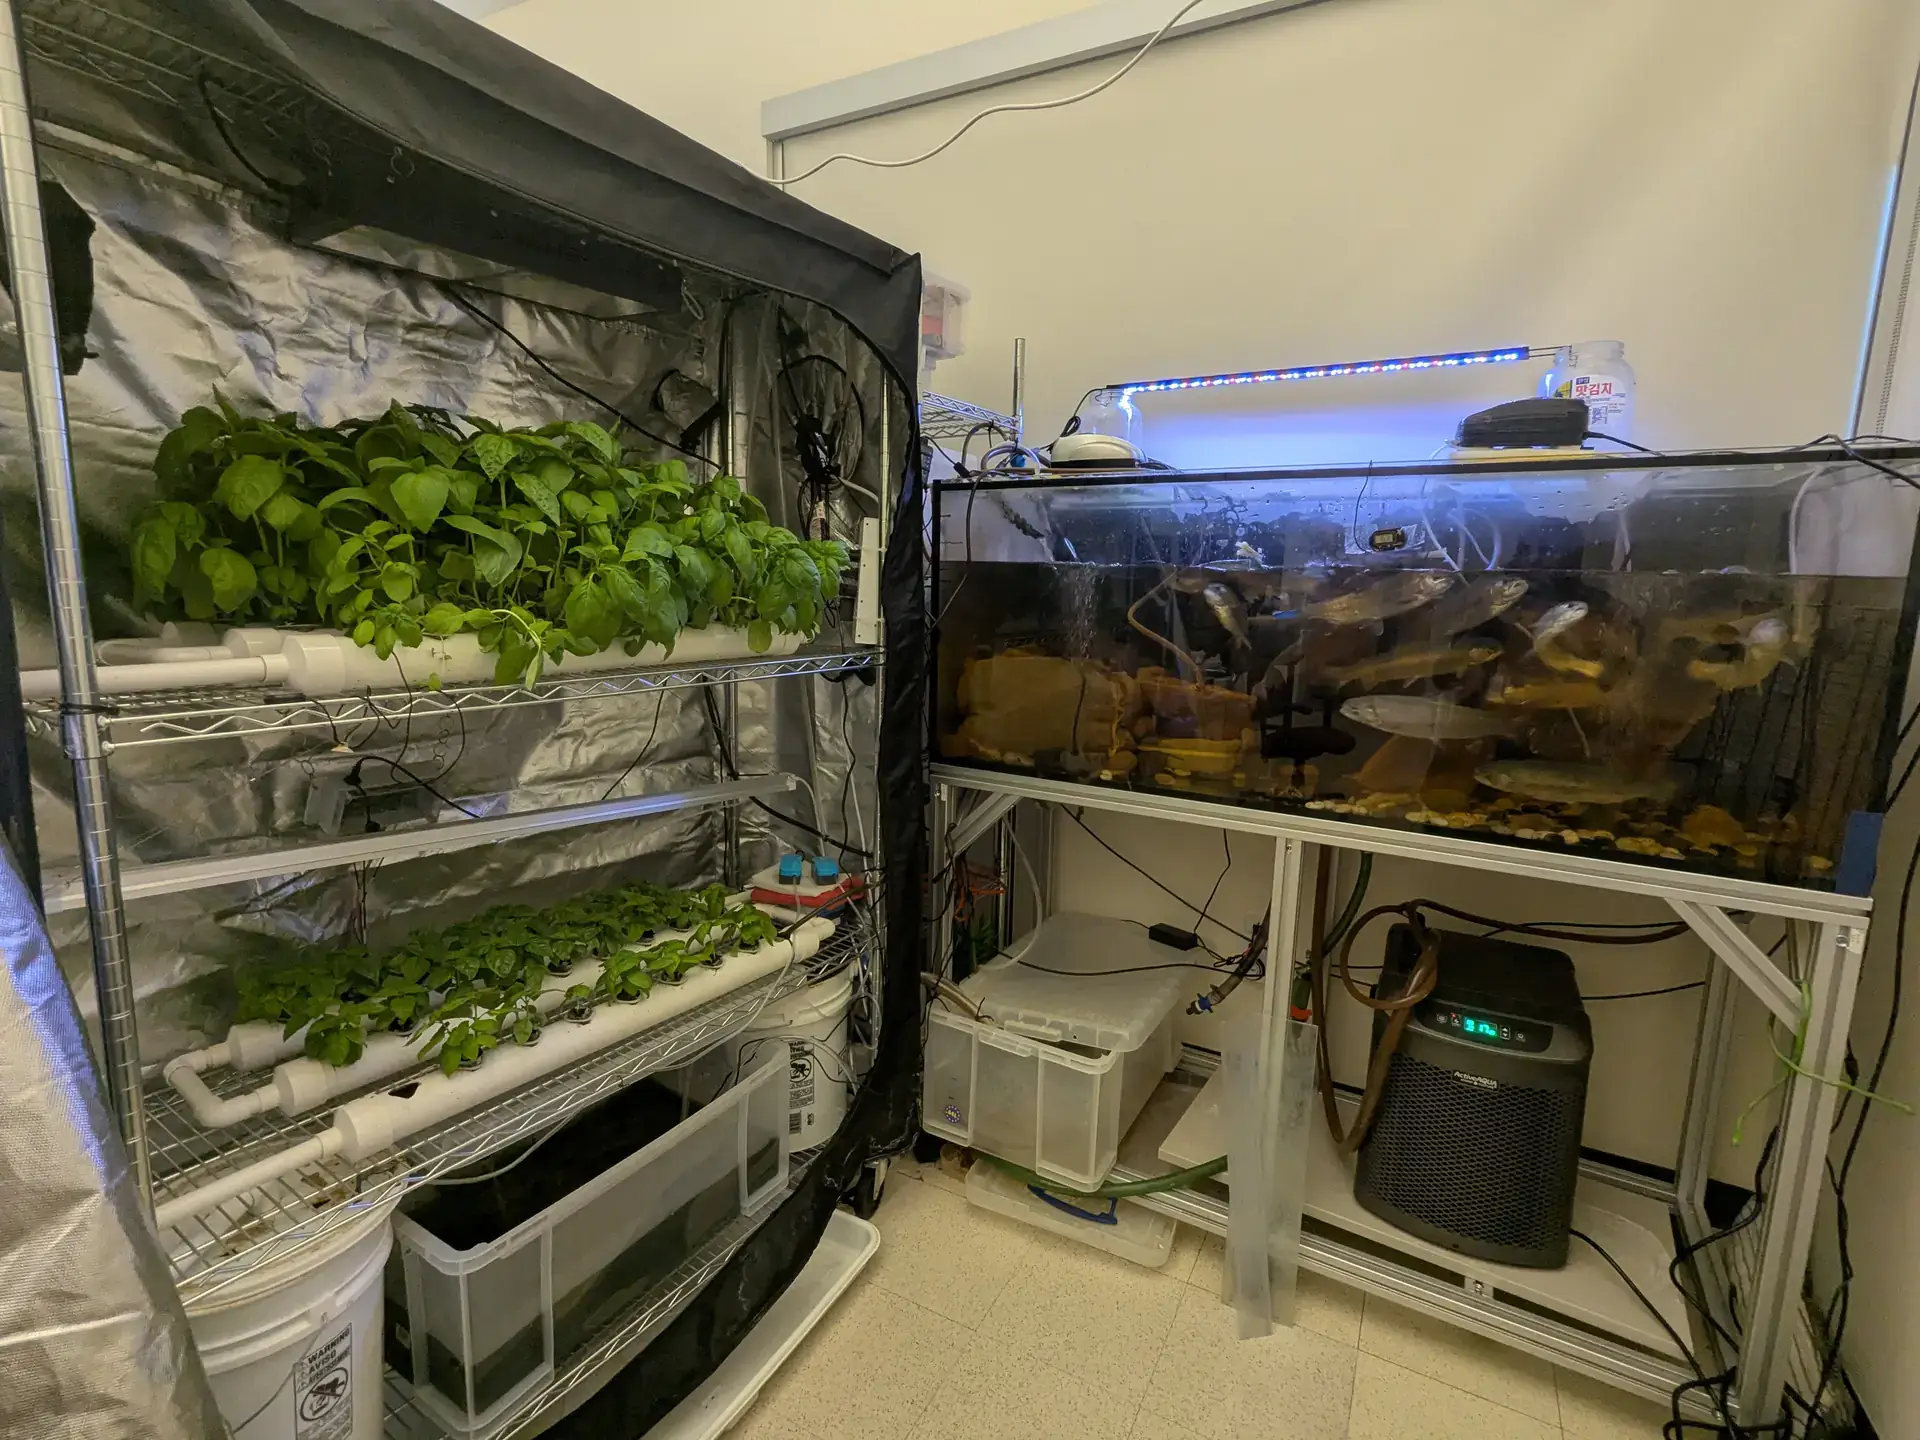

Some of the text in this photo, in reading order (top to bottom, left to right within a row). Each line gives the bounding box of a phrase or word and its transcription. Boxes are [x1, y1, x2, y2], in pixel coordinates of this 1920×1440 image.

[1454, 1071, 1497, 1089] ActiveAQUA
[308, 1327, 350, 1364] WARNING
[308, 1349, 337, 1374] AVISO
